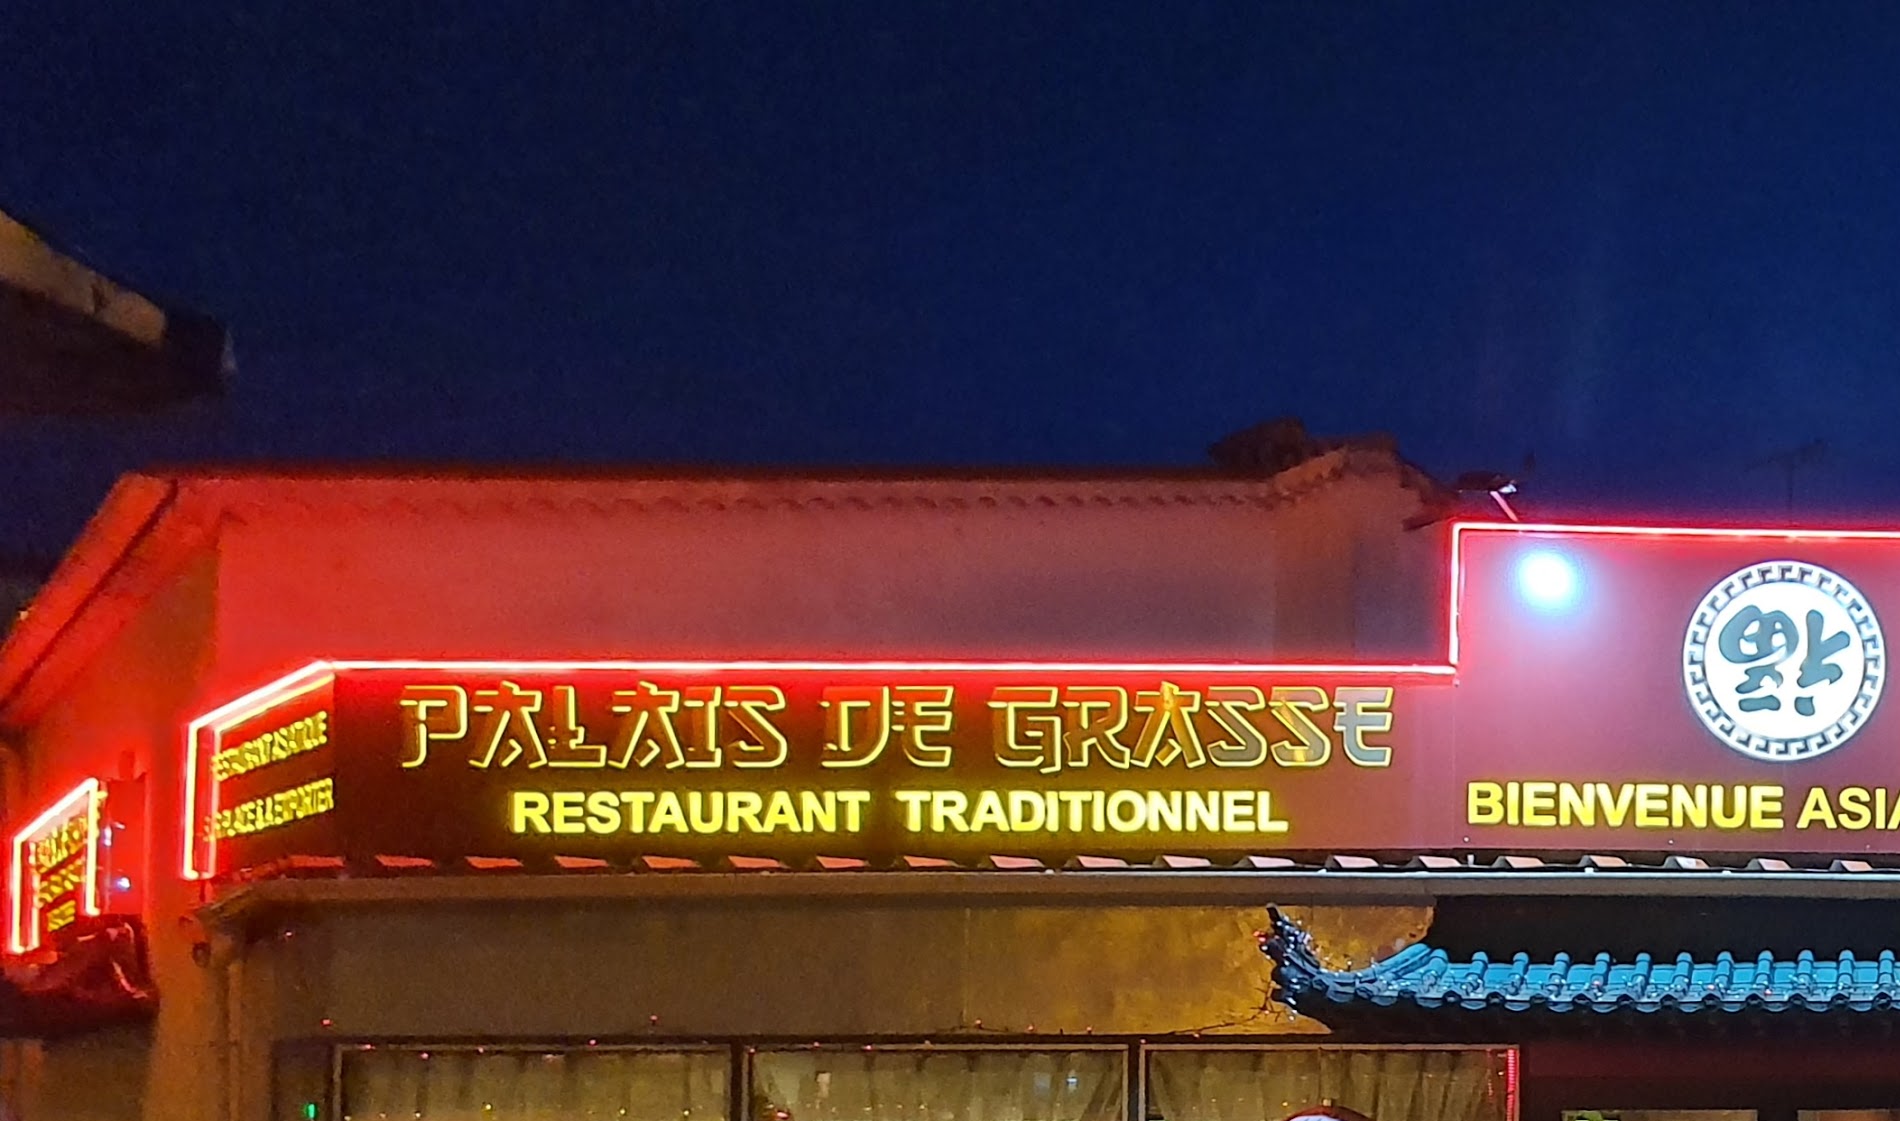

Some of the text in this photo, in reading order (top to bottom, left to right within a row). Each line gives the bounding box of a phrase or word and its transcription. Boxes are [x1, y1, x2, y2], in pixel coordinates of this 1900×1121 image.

[400, 681, 788, 769] PALAIS
[818, 685, 955, 769] DE
[986, 681, 1395, 774] GRASSE
[513, 790, 1289, 834] RESTAURANT TRADITIONNEL
[1467, 781, 1784, 829] BIENVENUE
